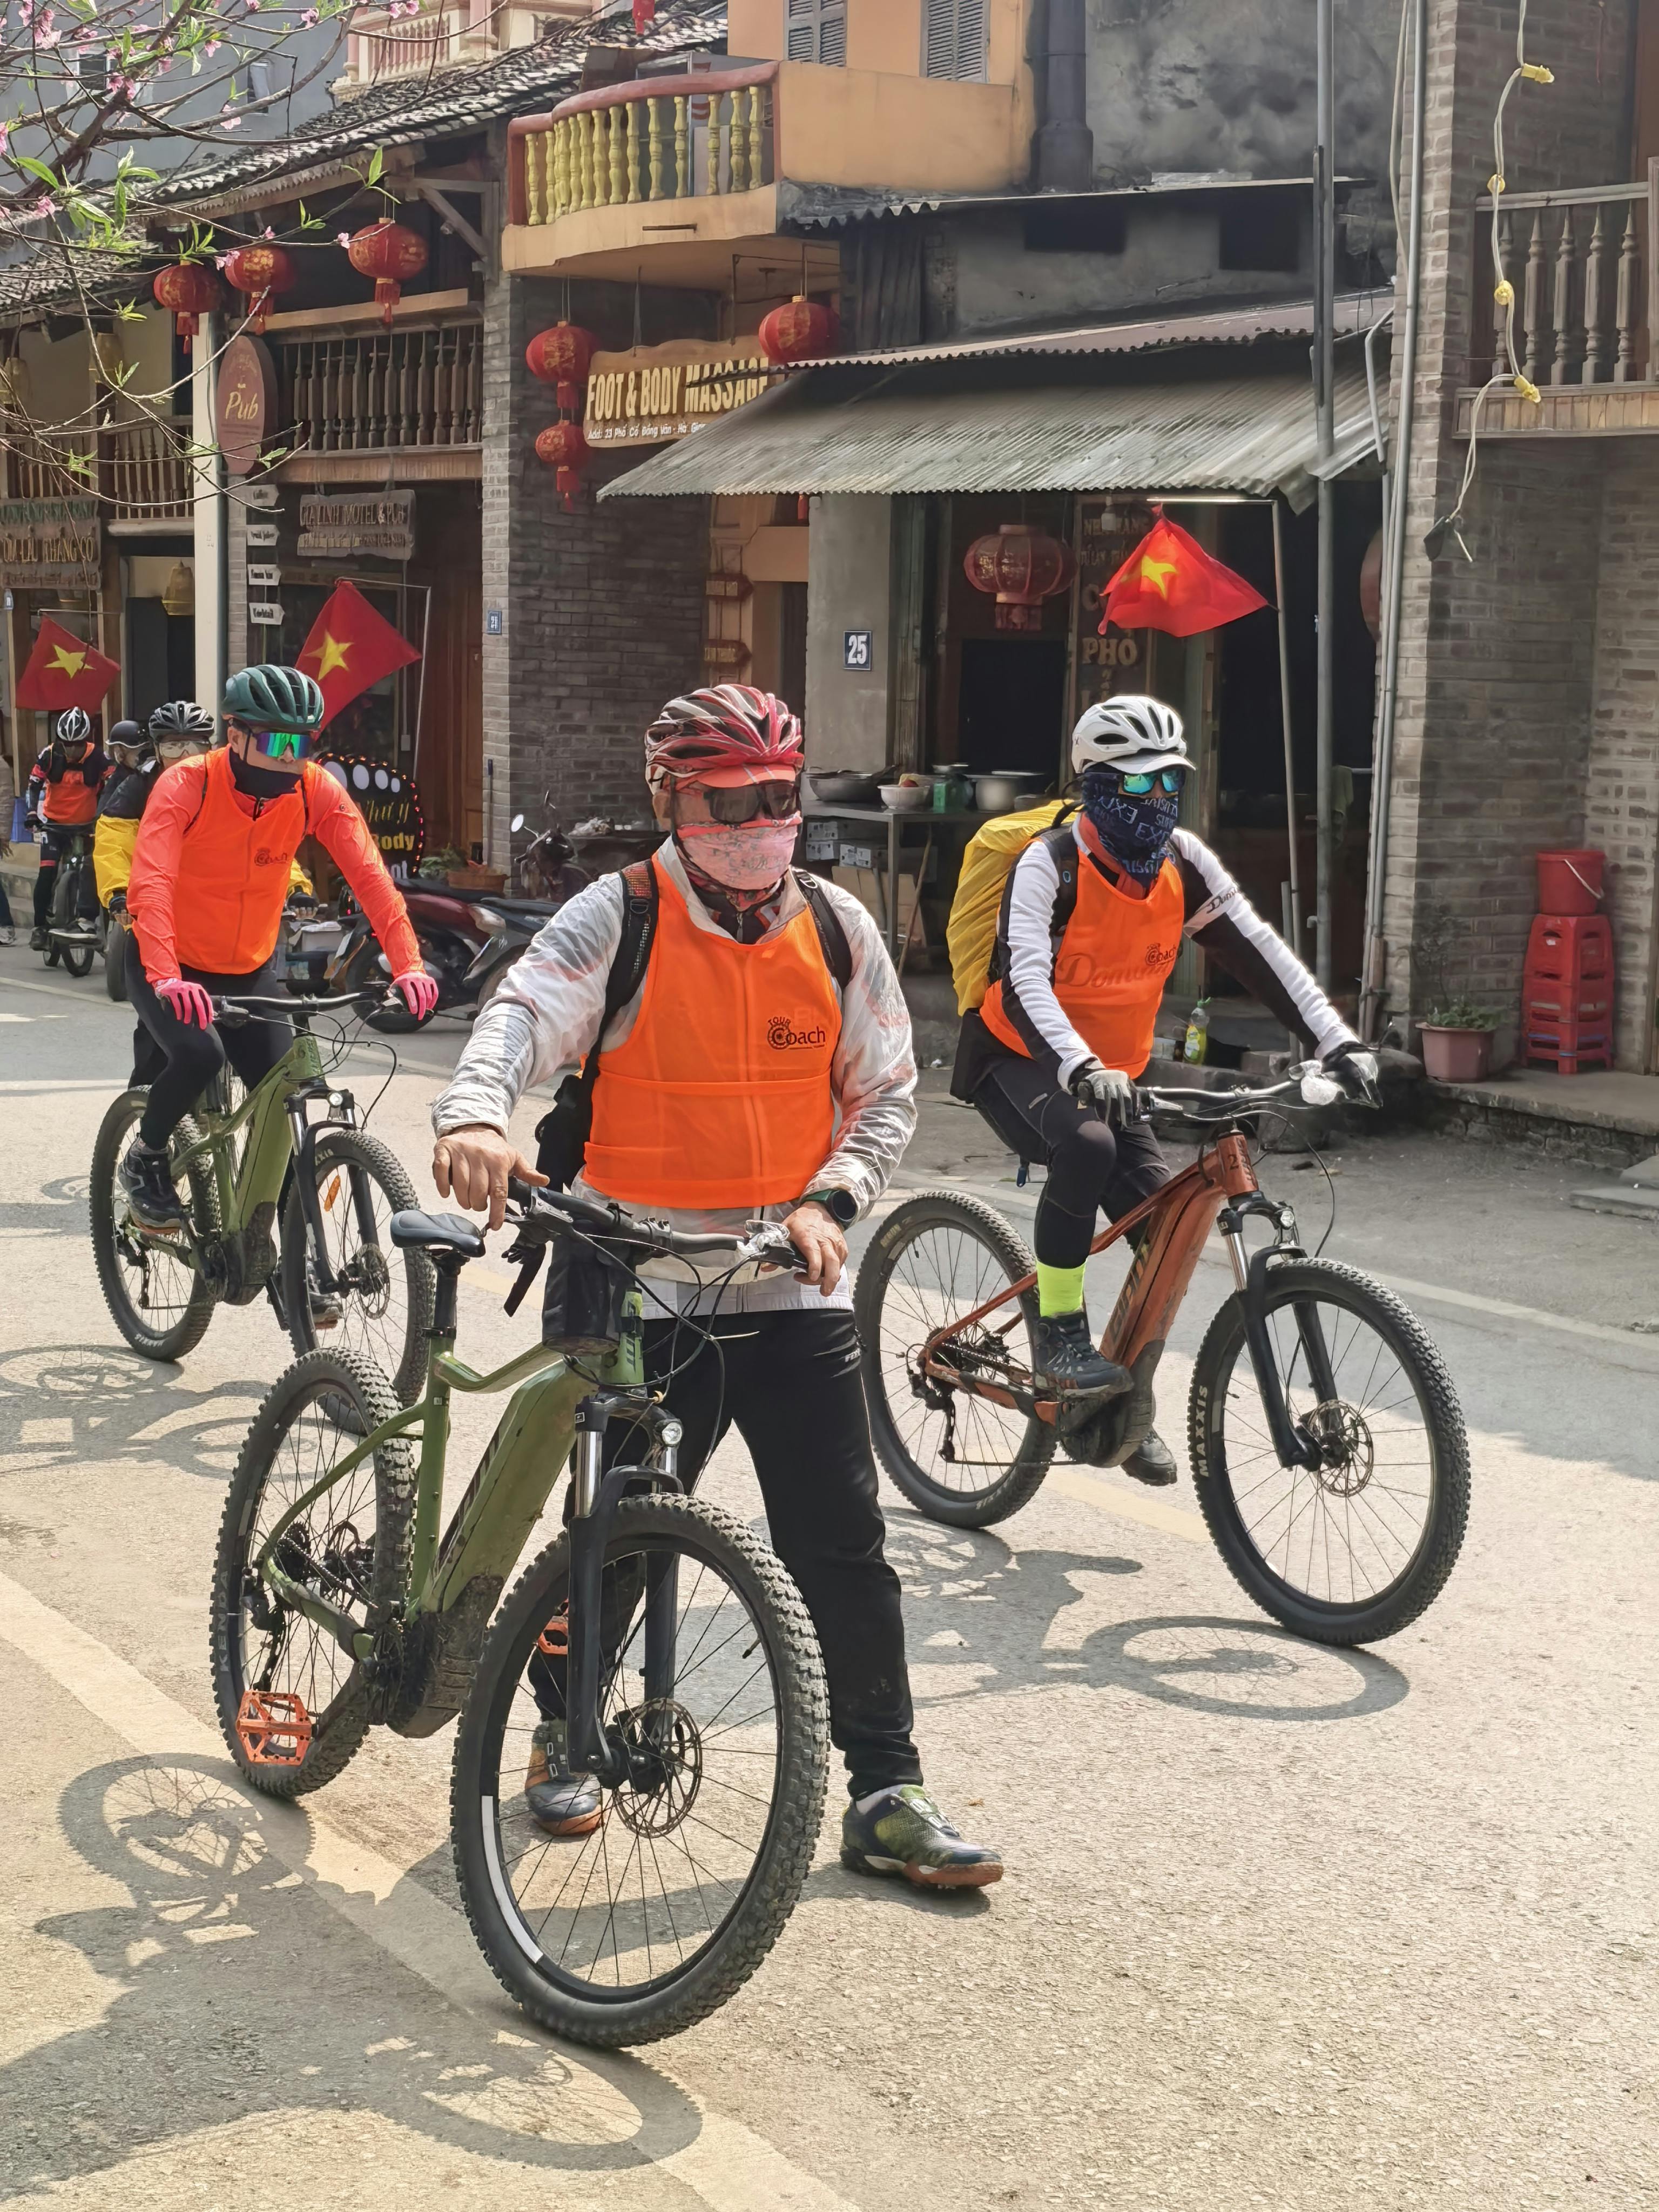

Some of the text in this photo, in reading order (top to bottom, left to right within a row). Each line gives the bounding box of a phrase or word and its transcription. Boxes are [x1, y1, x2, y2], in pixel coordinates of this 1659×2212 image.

[586, 357, 769, 420] FOOT & BODY MASSAGE
[225, 392, 259, 420] Pub
[847, 635, 867, 664] 25
[768, 1016, 791, 1028] TOUR
[768, 1026, 826, 1049] Coach
[1228, 1154, 1239, 1170] 2
[1195, 1385, 1209, 1478] MAXXIS
[217, 1570, 229, 1673] KENDA
